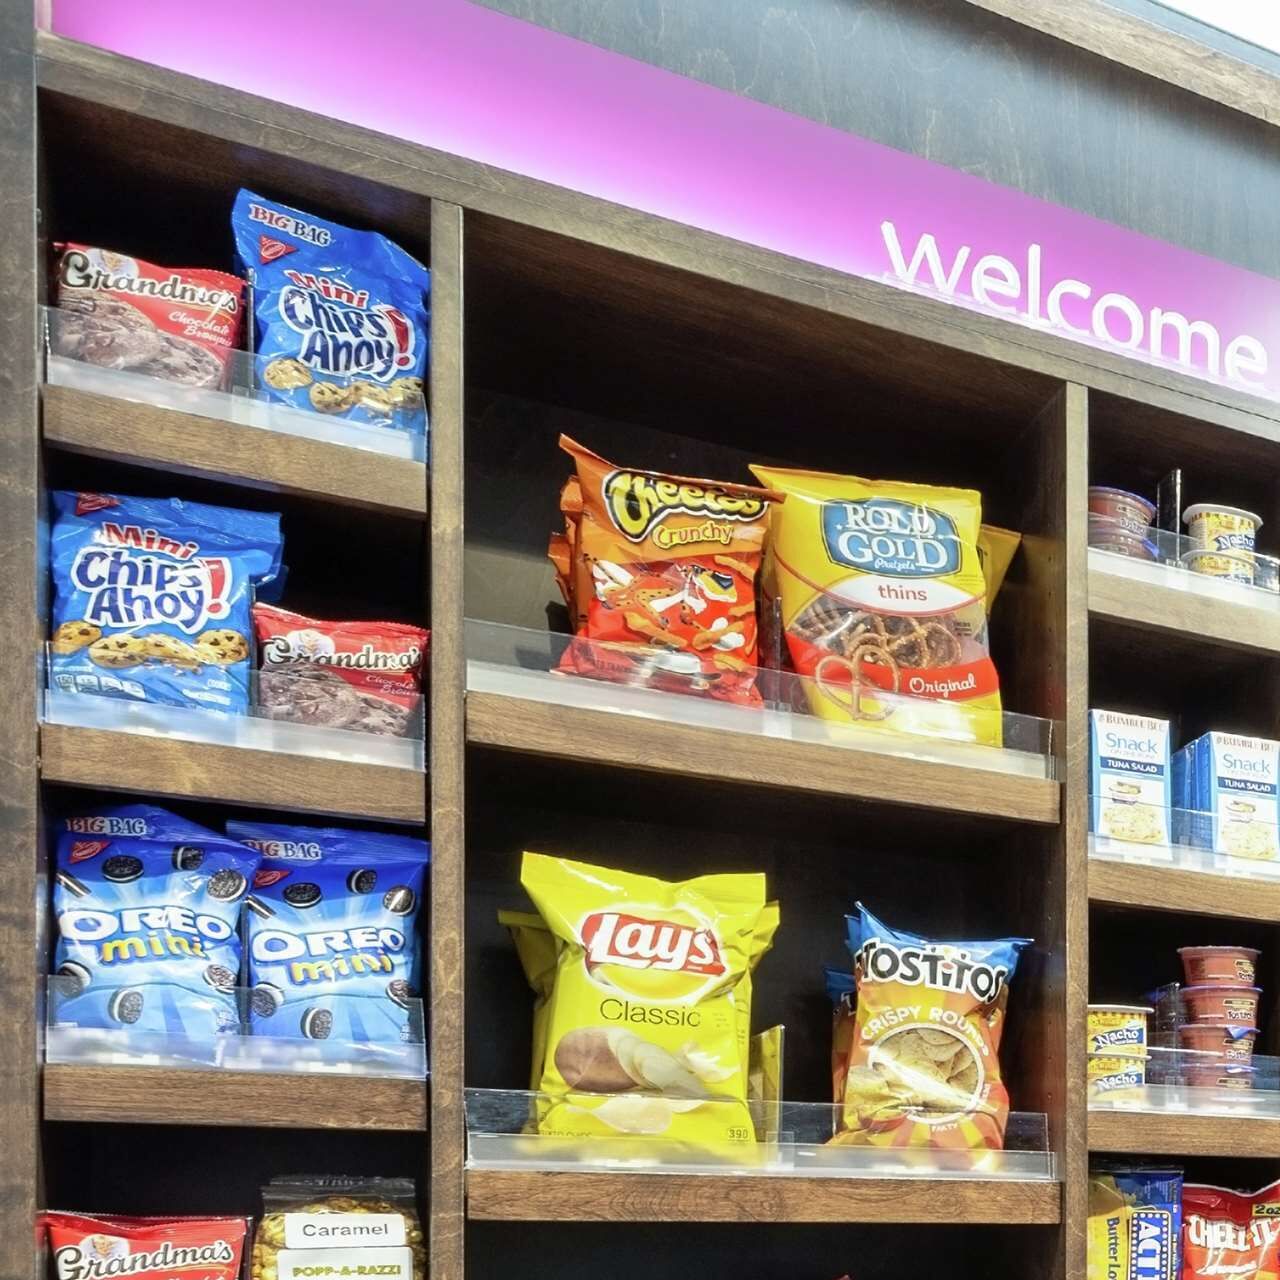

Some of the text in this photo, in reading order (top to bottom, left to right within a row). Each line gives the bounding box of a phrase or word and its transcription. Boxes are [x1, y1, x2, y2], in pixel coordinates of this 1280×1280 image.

[248, 203, 332, 247] BIG BAG
[284, 269, 369, 309] Mini
[881, 220, 1268, 380] welcome
[280, 287, 390, 338] Chips
[300, 305, 416, 384] Ahoy!
[652, 519, 734, 548] Crunchy
[846, 503, 938, 538] ROLD
[101, 522, 198, 561] Mini
[838, 531, 948, 571] GOLD
[75, 549, 206, 591] Chips
[88, 558, 227, 632] Ahoy!
[878, 582, 928, 603] thins
[265, 633, 422, 674] Grandma's
[909, 674, 977, 698] Original
[1105, 732, 1158, 754] Snack
[1107, 759, 1158, 774] TUNA SALAD
[1222, 753, 1272, 775] Snack
[1225, 779, 1271, 793] TUNA SALAD
[110, 817, 147, 836] BAG
[283, 840, 321, 860] BAG
[60, 906, 232, 940] OREO
[103, 930, 205, 963] mini
[252, 927, 405, 963] OREO
[291, 949, 393, 983] mini
[600, 998, 701, 1028] Classic
[861, 1006, 922, 1041] CRISPY
[1097, 1028, 1139, 1047] Nacho
[1098, 1072, 1138, 1091] Nacho
[302, 1223, 389, 1238] Caramel
[1106, 1217, 1120, 1262] Butter
[292, 1264, 401, 1278] POPP-A-RAZZI
